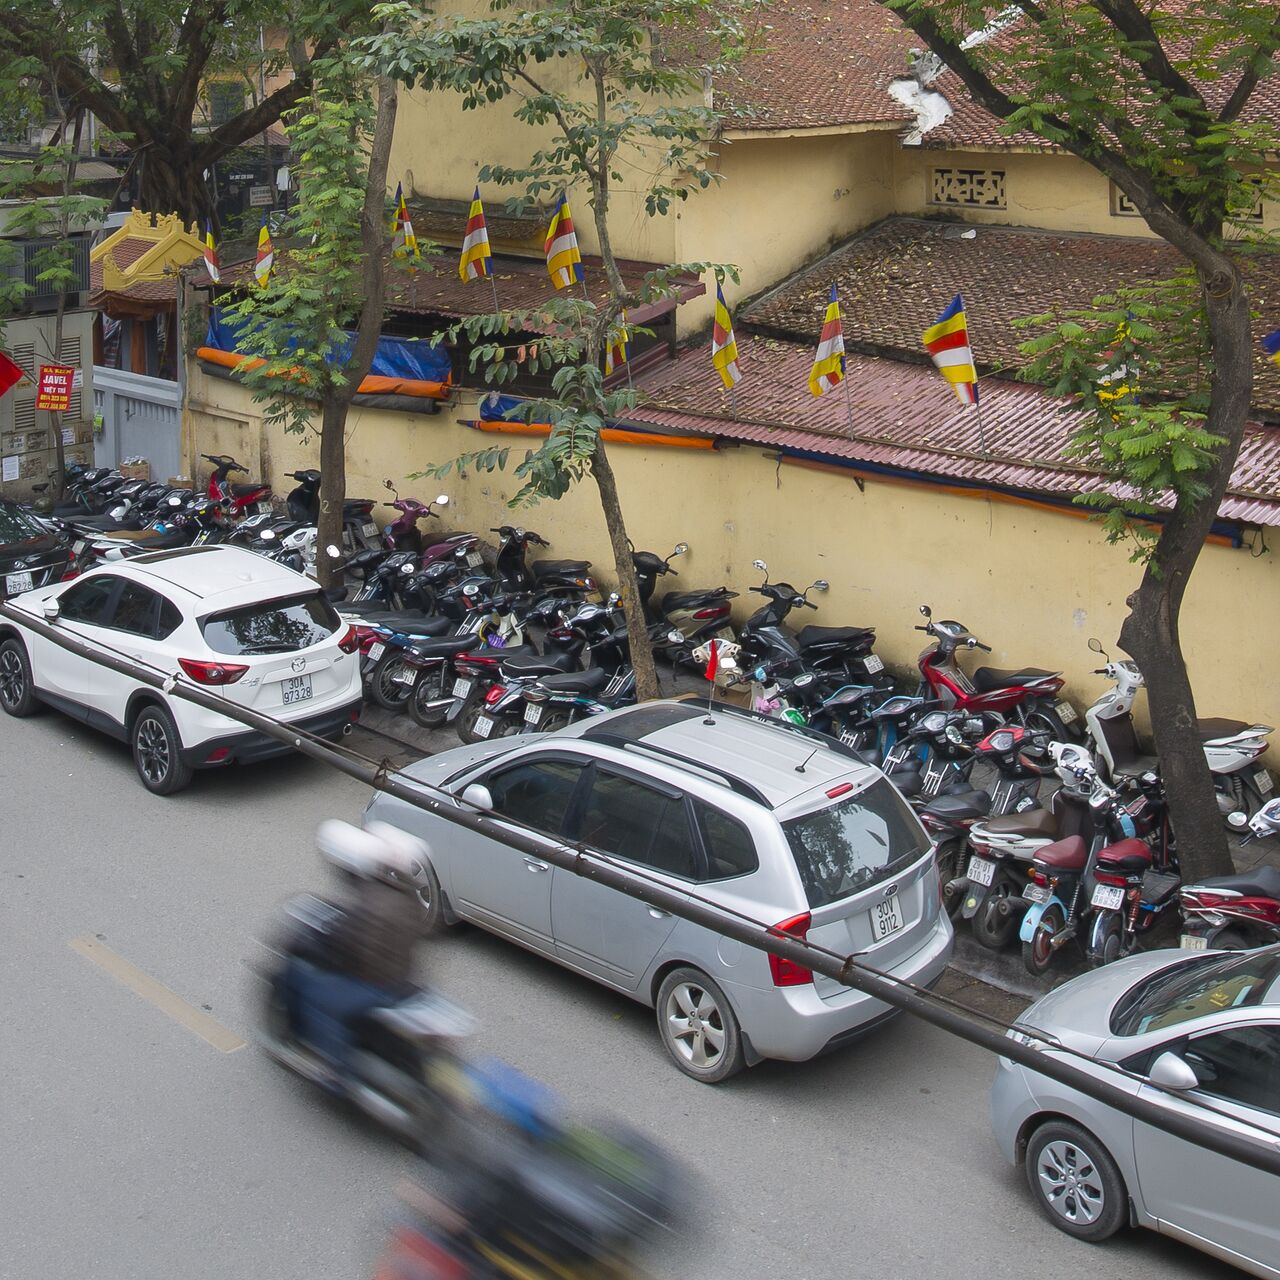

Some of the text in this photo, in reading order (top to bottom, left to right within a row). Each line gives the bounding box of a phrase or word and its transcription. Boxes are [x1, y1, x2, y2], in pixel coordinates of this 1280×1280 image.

[43, 375, 67, 385] JAVEL
[288, 676, 306, 690] 30A
[880, 914, 898, 935] 9112
